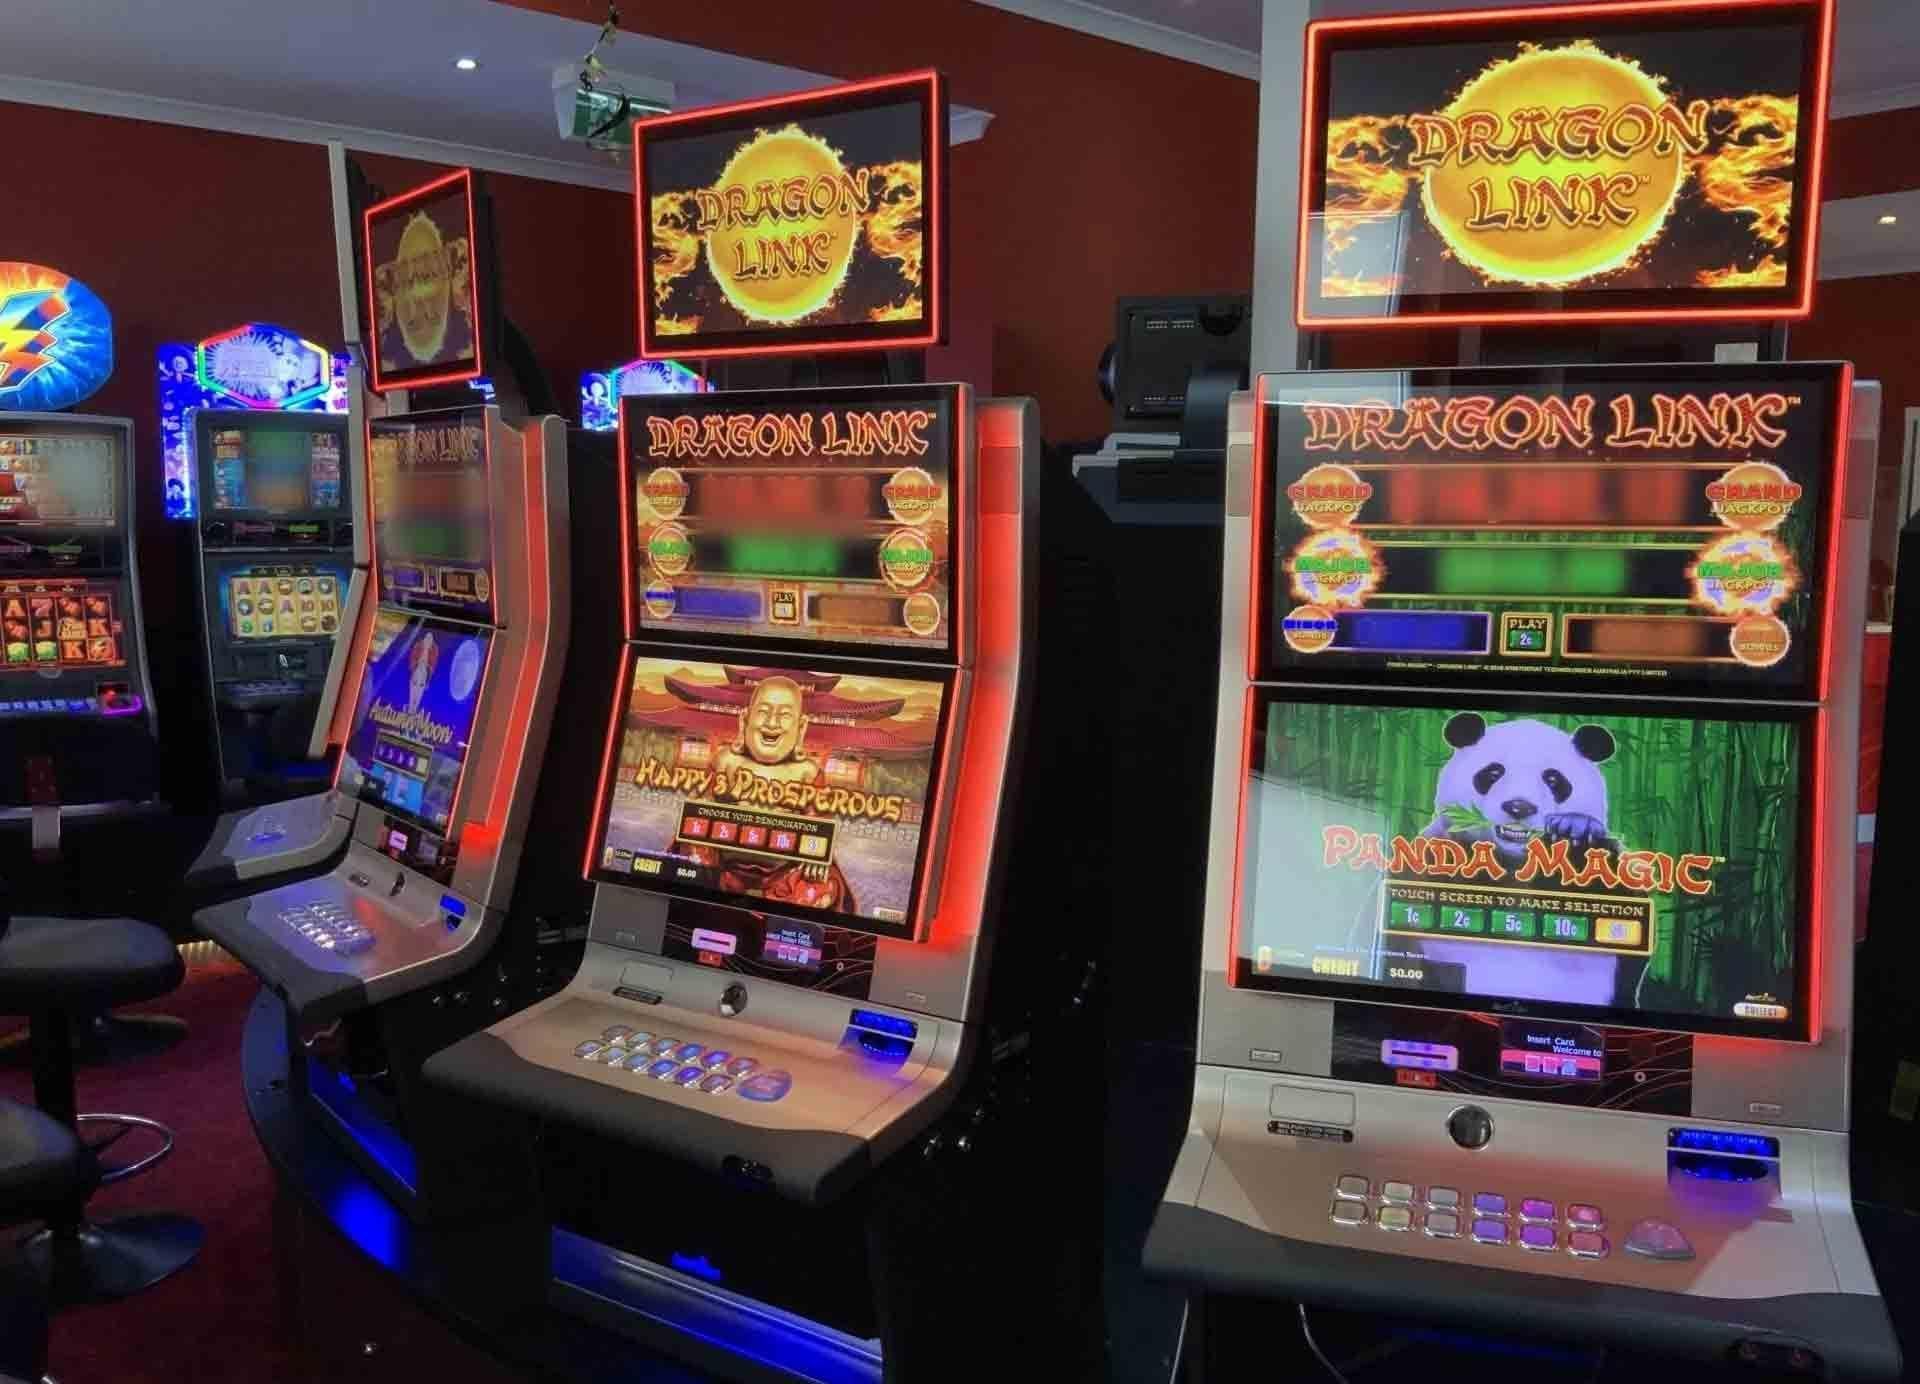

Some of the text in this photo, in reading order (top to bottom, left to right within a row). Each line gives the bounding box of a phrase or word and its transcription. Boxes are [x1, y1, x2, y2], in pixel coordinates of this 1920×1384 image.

[1408, 100, 1710, 167] DRAGON
[695, 167, 870, 232] DRAGON
[1303, 394, 1593, 451] DRAGON
[647, 415, 813, 457] DRAGON
[1287, 481, 1373, 499] GRAND
[1706, 481, 1801, 500] GRAND
[1293, 500, 1363, 514] JACKPOT
[1711, 501, 1794, 515] JACKPOT
[1508, 618, 1545, 630] PLAY
[637, 756, 712, 790] HAPPY
[731, 768, 905, 822] PROSPEROUS
[732, 811, 754, 823] YOUR
[1321, 824, 1507, 881] PANDA
[1391, 888, 1644, 917] TOUCH SCREEN TO MAKE SELECTION
[1454, 910, 1471, 928] 2c
[1554, 918, 1577, 936] 10c
[1312, 957, 1424, 980] CREDIT $0.00
[1527, 1034, 1575, 1048] Insert Card
[1552, 1044, 1602, 1058] Welcome to
